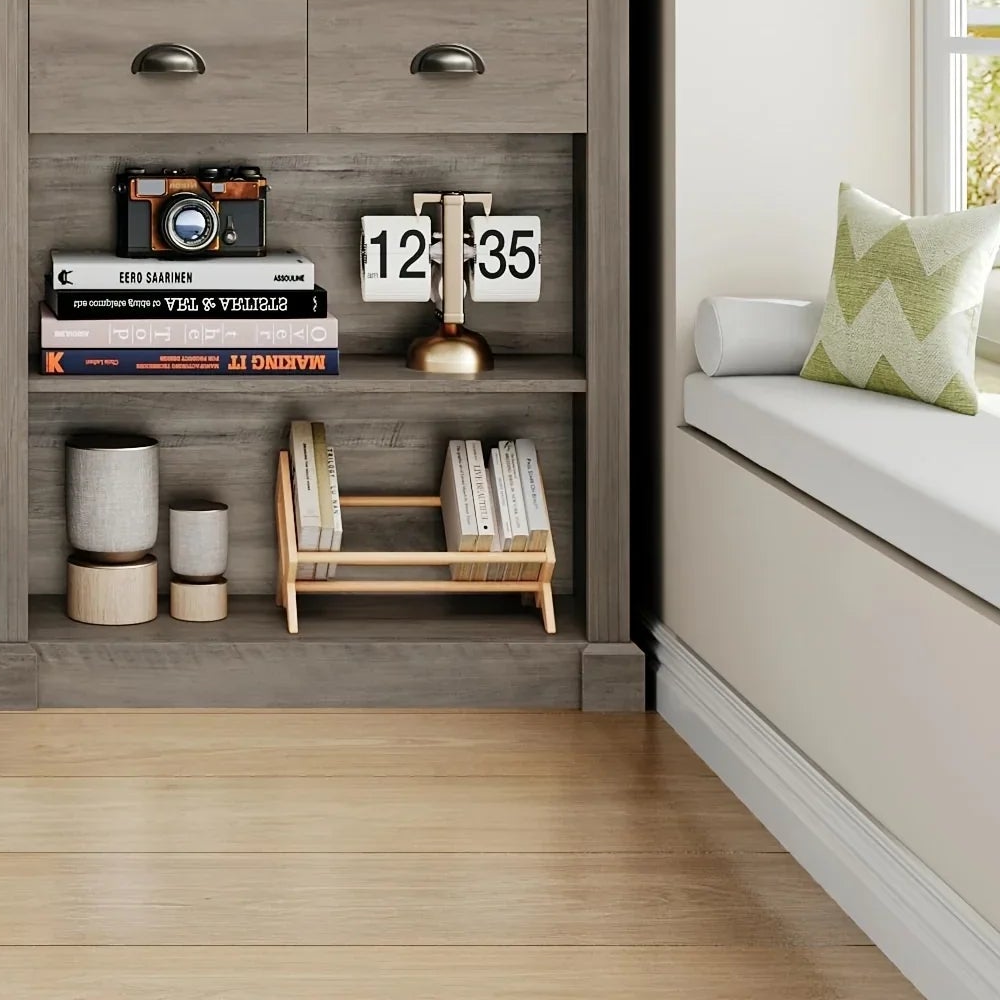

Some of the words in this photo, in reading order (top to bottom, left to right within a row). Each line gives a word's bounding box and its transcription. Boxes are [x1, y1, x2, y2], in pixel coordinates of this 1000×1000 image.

[370, 229, 426, 279] 12
[478, 229, 536, 280] 35
[119, 271, 143, 284] EERO
[146, 271, 193, 284] SAARINEN
[273, 274, 305, 282] ASSOULINE
[227, 354, 247, 370] IT
[251, 354, 326, 370] MAKING
